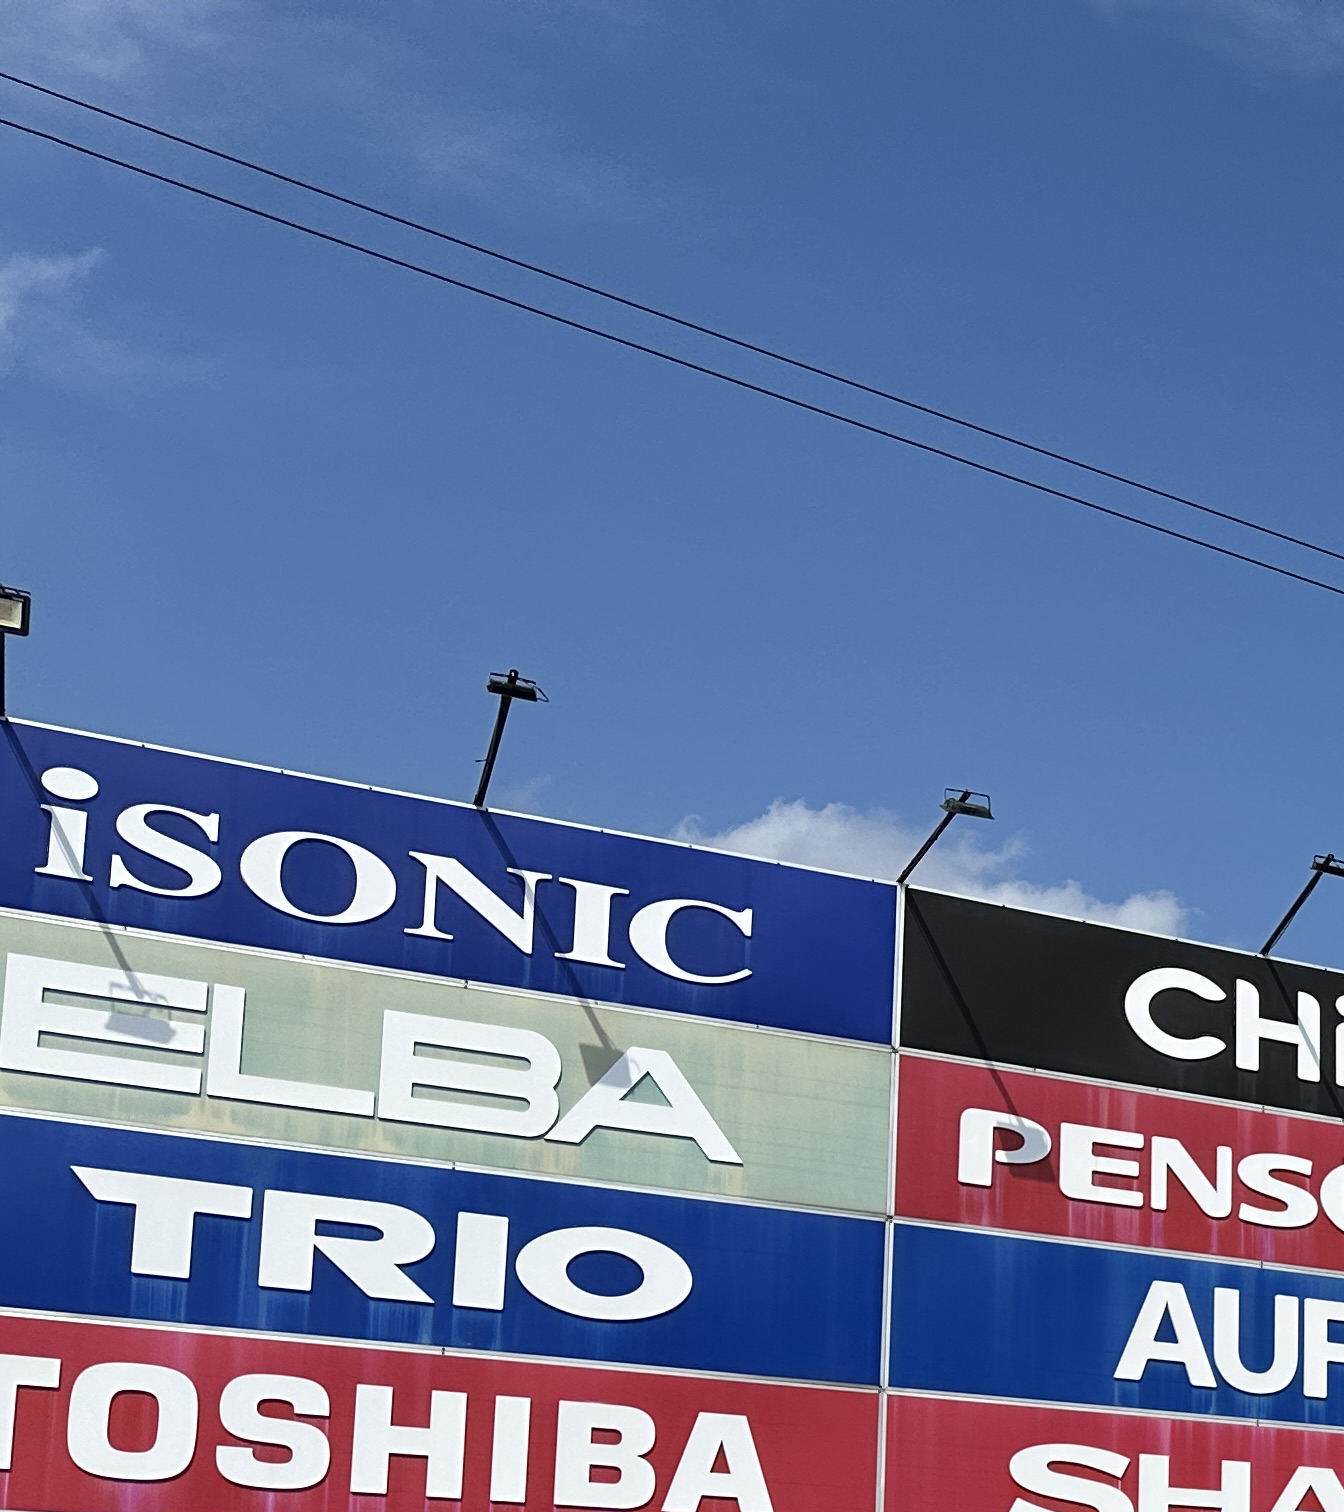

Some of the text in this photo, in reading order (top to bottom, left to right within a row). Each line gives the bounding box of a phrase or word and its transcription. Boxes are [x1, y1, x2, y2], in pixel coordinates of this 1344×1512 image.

[35, 766, 753, 984] iSONIC
[0, 953, 743, 1165] ELBA
[70, 1165, 693, 1321] TRIO
